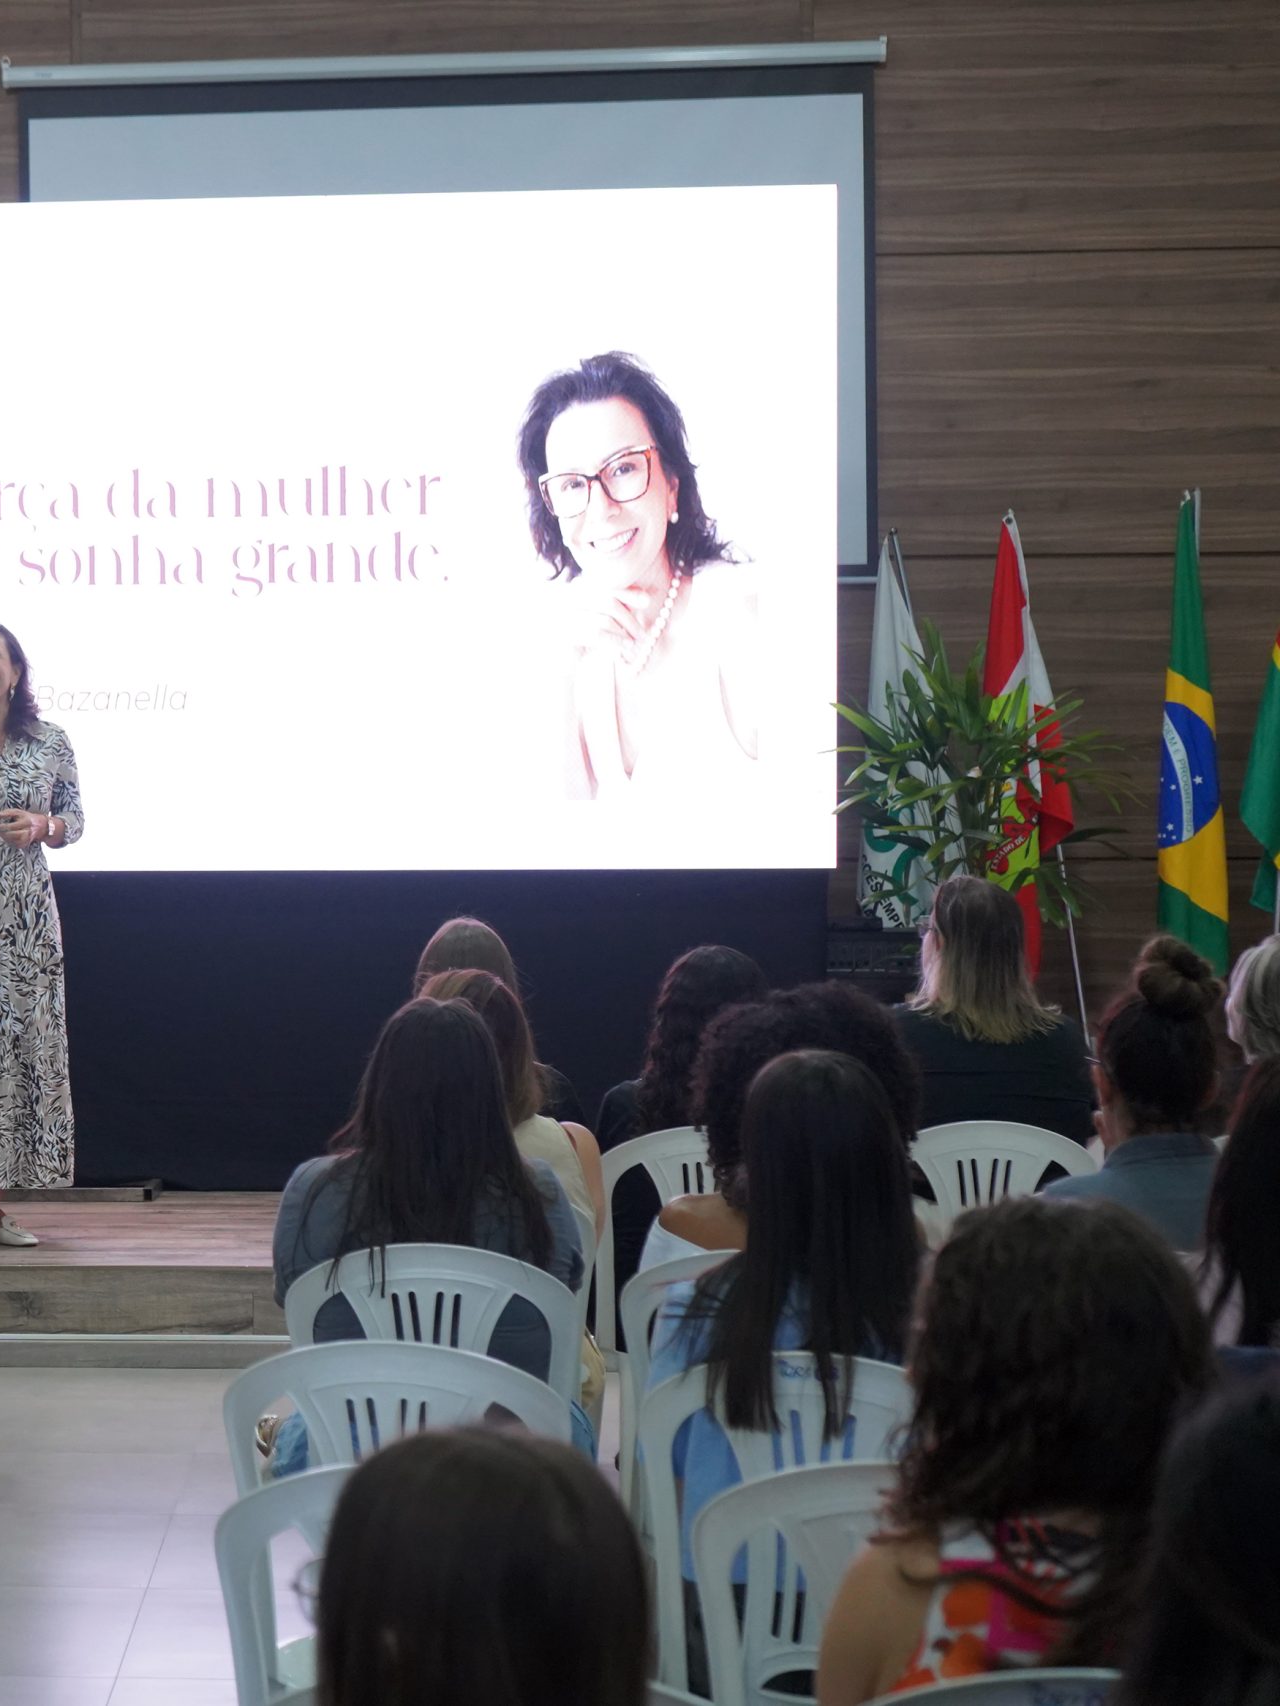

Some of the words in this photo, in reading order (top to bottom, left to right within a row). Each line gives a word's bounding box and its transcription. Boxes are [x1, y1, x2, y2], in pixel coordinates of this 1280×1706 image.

[106, 468, 178, 520] da
[206, 464, 442, 518] mulher
[18, 533, 205, 587] sonha
[231, 530, 451, 598] grande.
[35, 684, 189, 713] Bazanella
